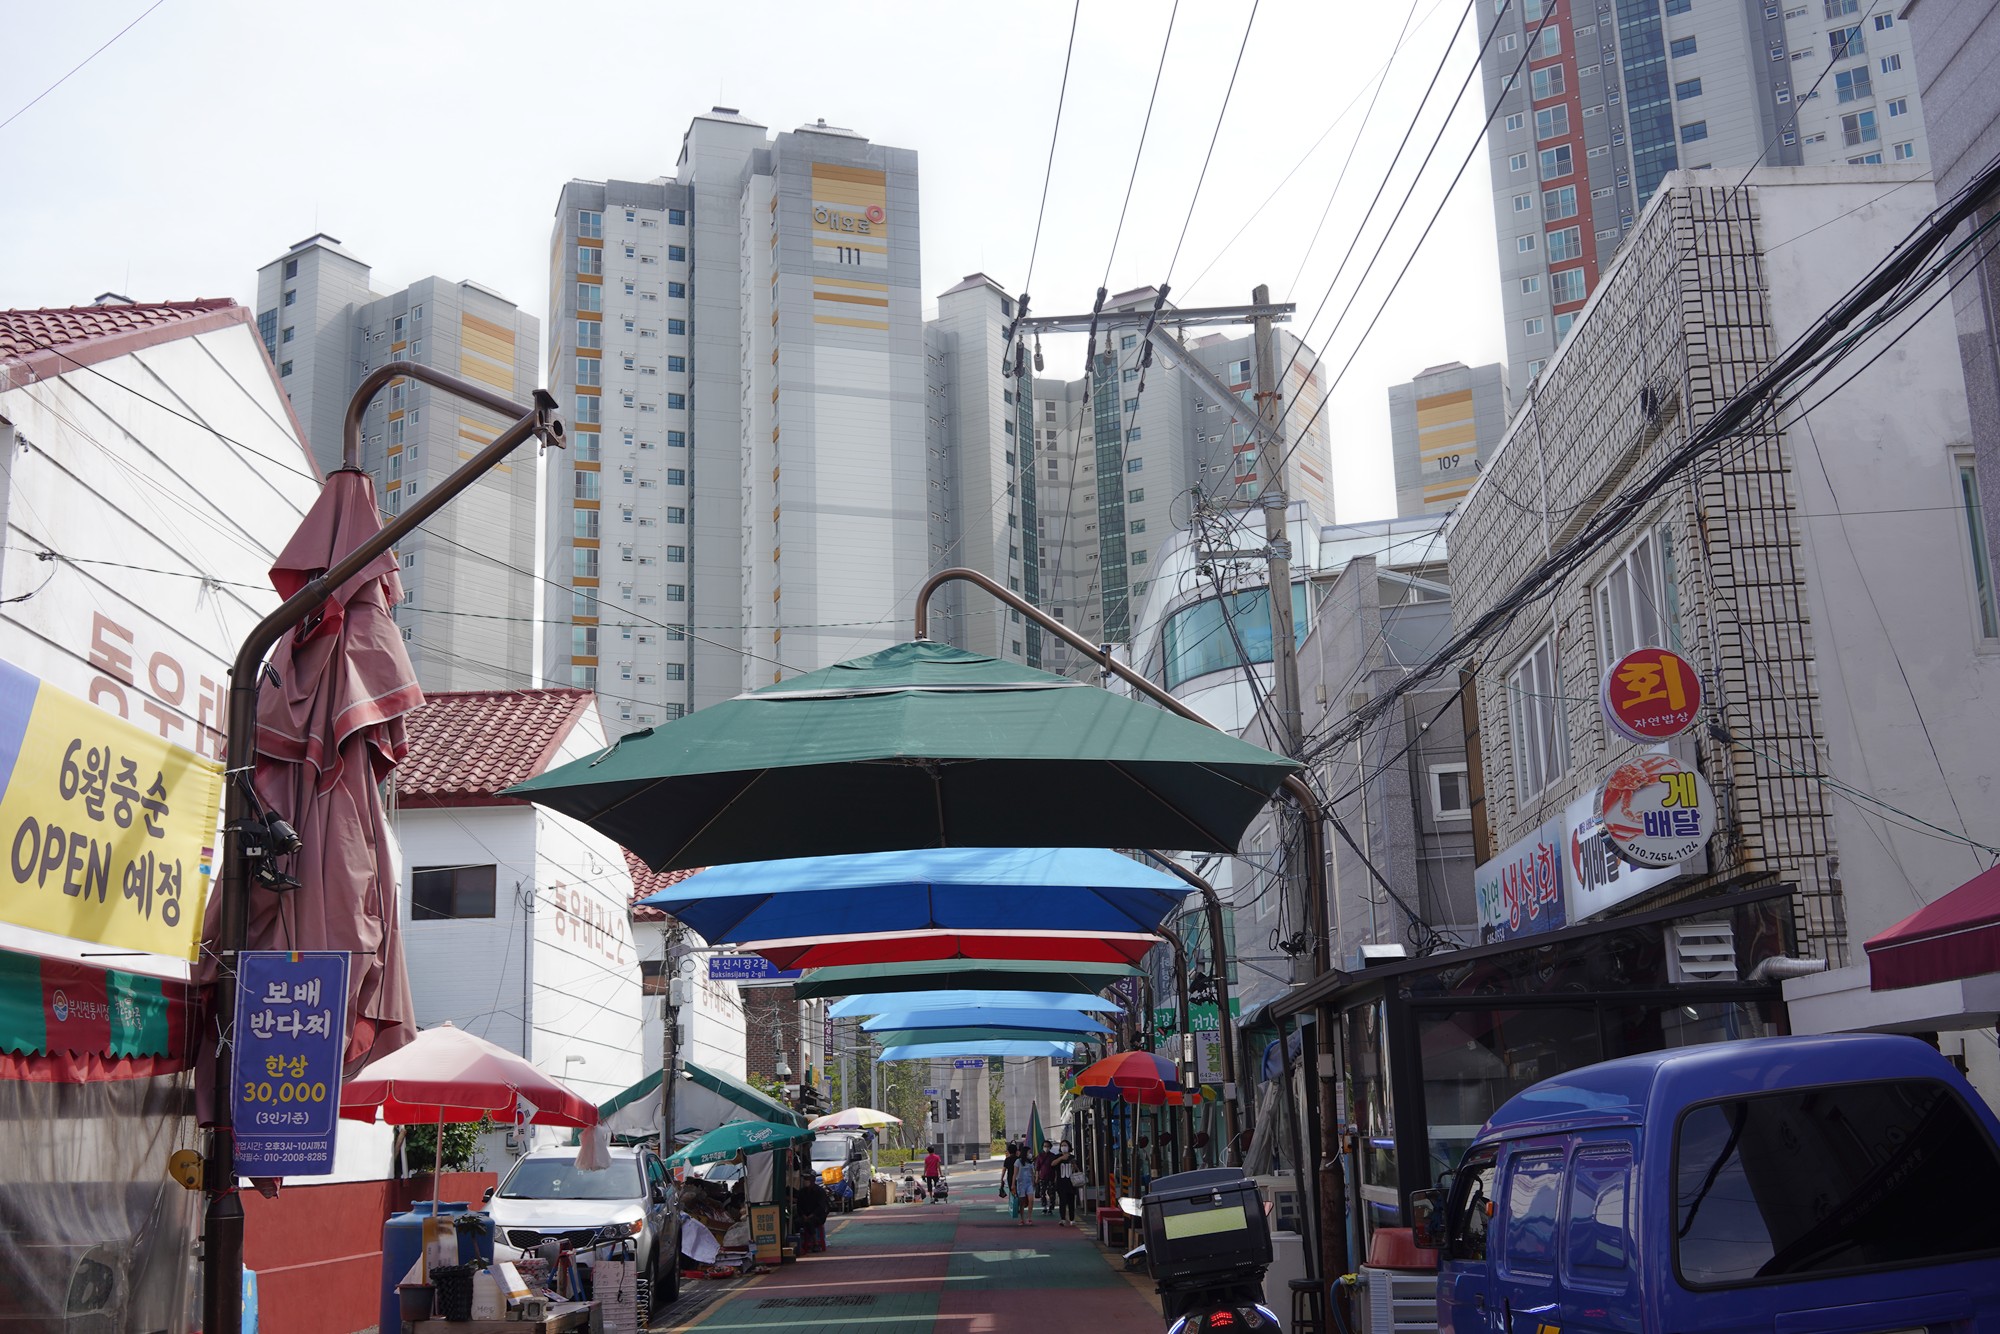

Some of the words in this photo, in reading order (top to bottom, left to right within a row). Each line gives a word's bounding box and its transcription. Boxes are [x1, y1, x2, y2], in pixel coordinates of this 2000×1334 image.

[836, 246, 861, 266] 111
[1437, 454, 1460, 471] 109
[1617, 655, 1687, 711] 회
[1634, 712, 1689, 728] 자연밥상
[59, 738, 170, 839] 6월중순
[1659, 771, 1699, 808] 게
[1642, 809, 1701, 839] 배달
[1628, 841, 1699, 861] 010.7454.1124
[11, 815, 112, 904] OPEN
[122, 850, 182, 928] 예정
[1481, 875, 1501, 923] 자연
[1502, 841, 1557, 931] 생선회
[555, 879, 625, 966] 동우테라스2
[711, 959, 769, 970] 북신시장2길
[711, 971, 749, 979] Buksinsijang
[751, 970, 766, 979] 2-gil
[262, 977, 321, 1008] 보배
[68, 998, 110, 1022] 북신전통시장
[250, 1008, 331, 1040] 반다찌
[265, 1054, 309, 1078] 한상
[243, 1082, 326, 1106] 30,000
[255, 1111, 309, 1126] (3인기준)
[263, 1152, 328, 1162] 010-2008-8285
[264, 1141, 327, 1151] 오후3시~10시까지
